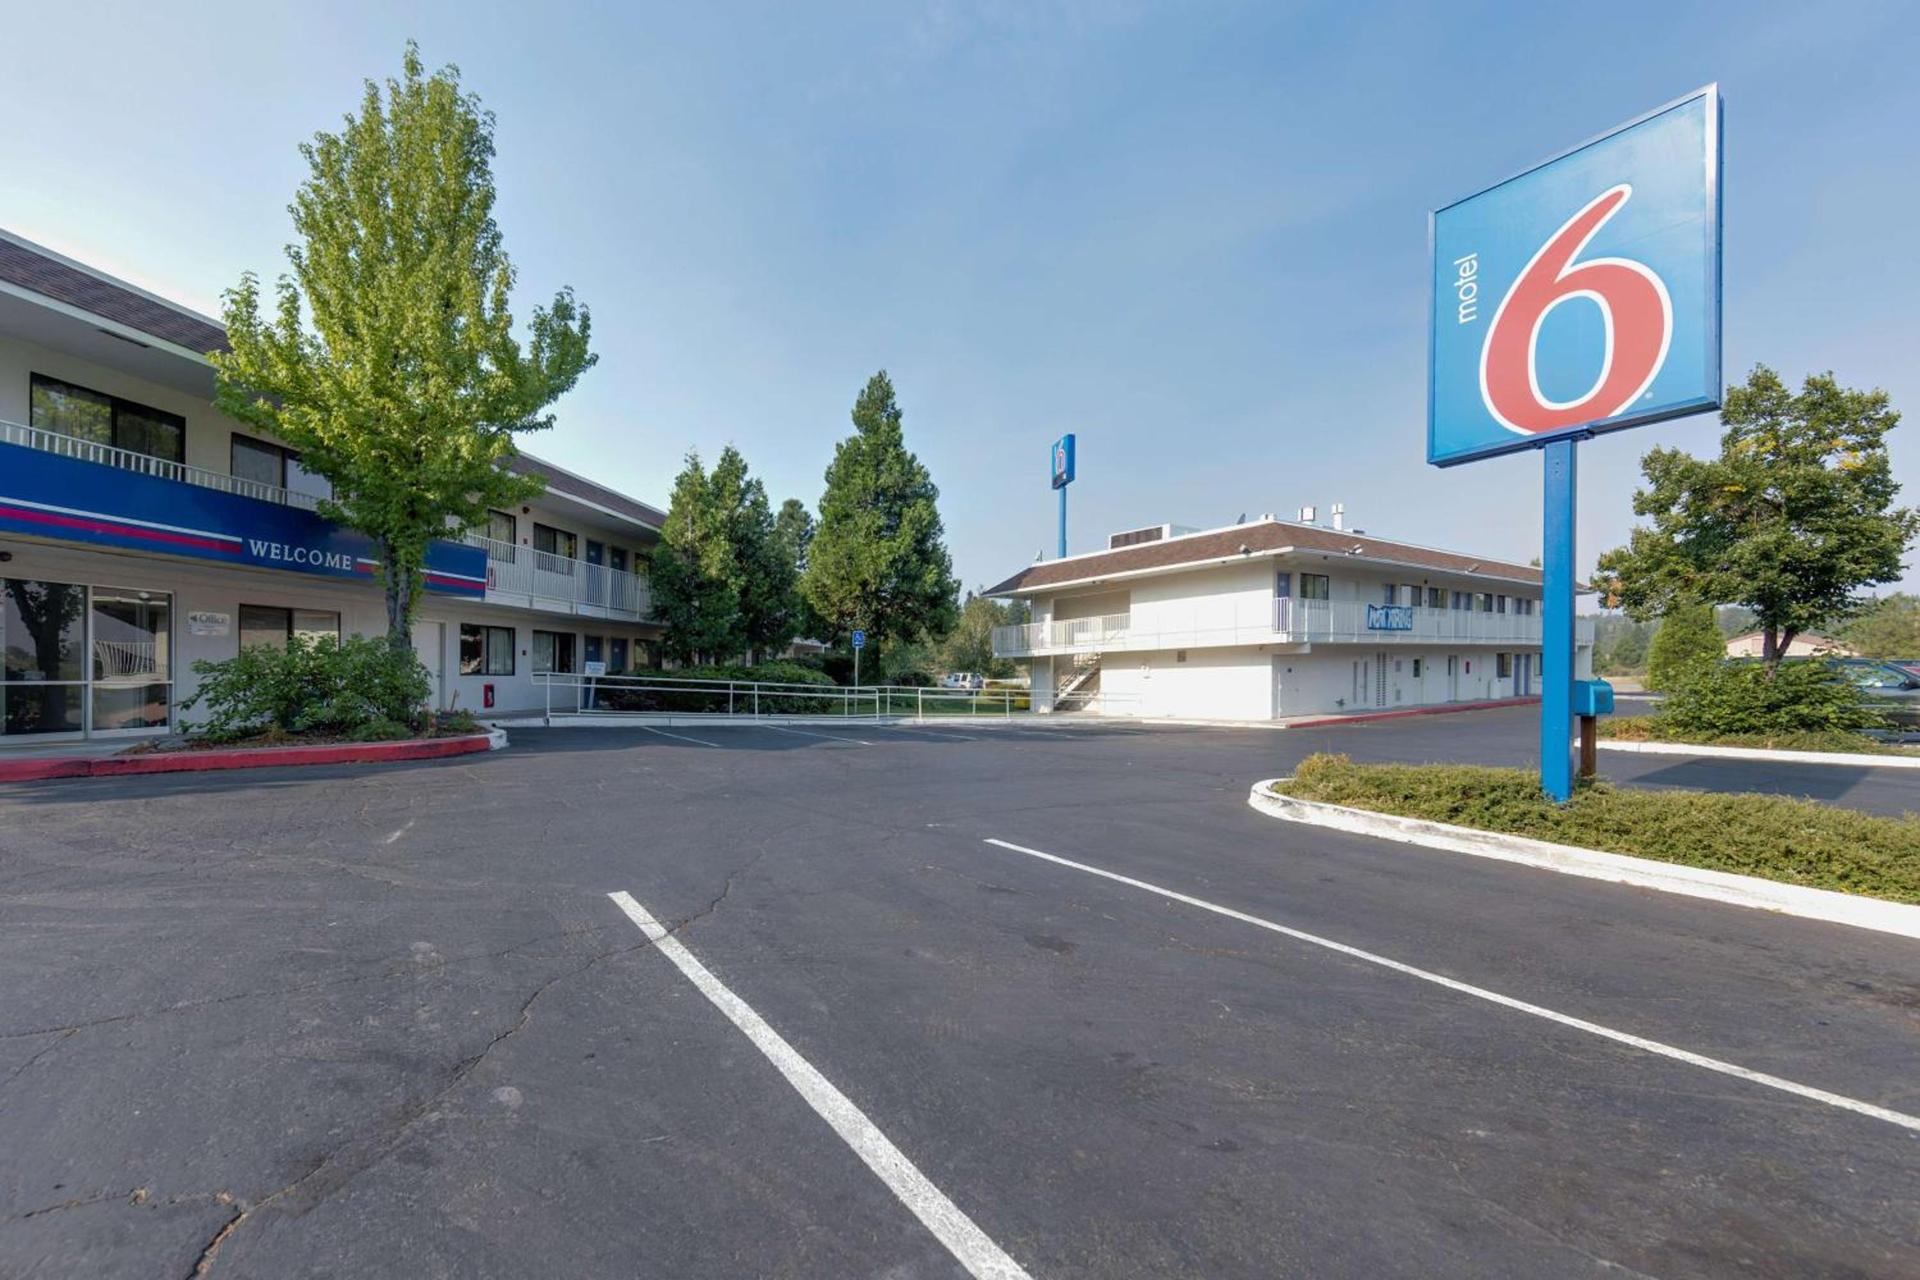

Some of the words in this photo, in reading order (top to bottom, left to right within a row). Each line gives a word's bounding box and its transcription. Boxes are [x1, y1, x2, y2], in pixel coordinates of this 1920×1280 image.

[1453, 253, 1478, 325] motel
[1479, 184, 1673, 436] 6
[248, 539, 352, 571] WELCOME
